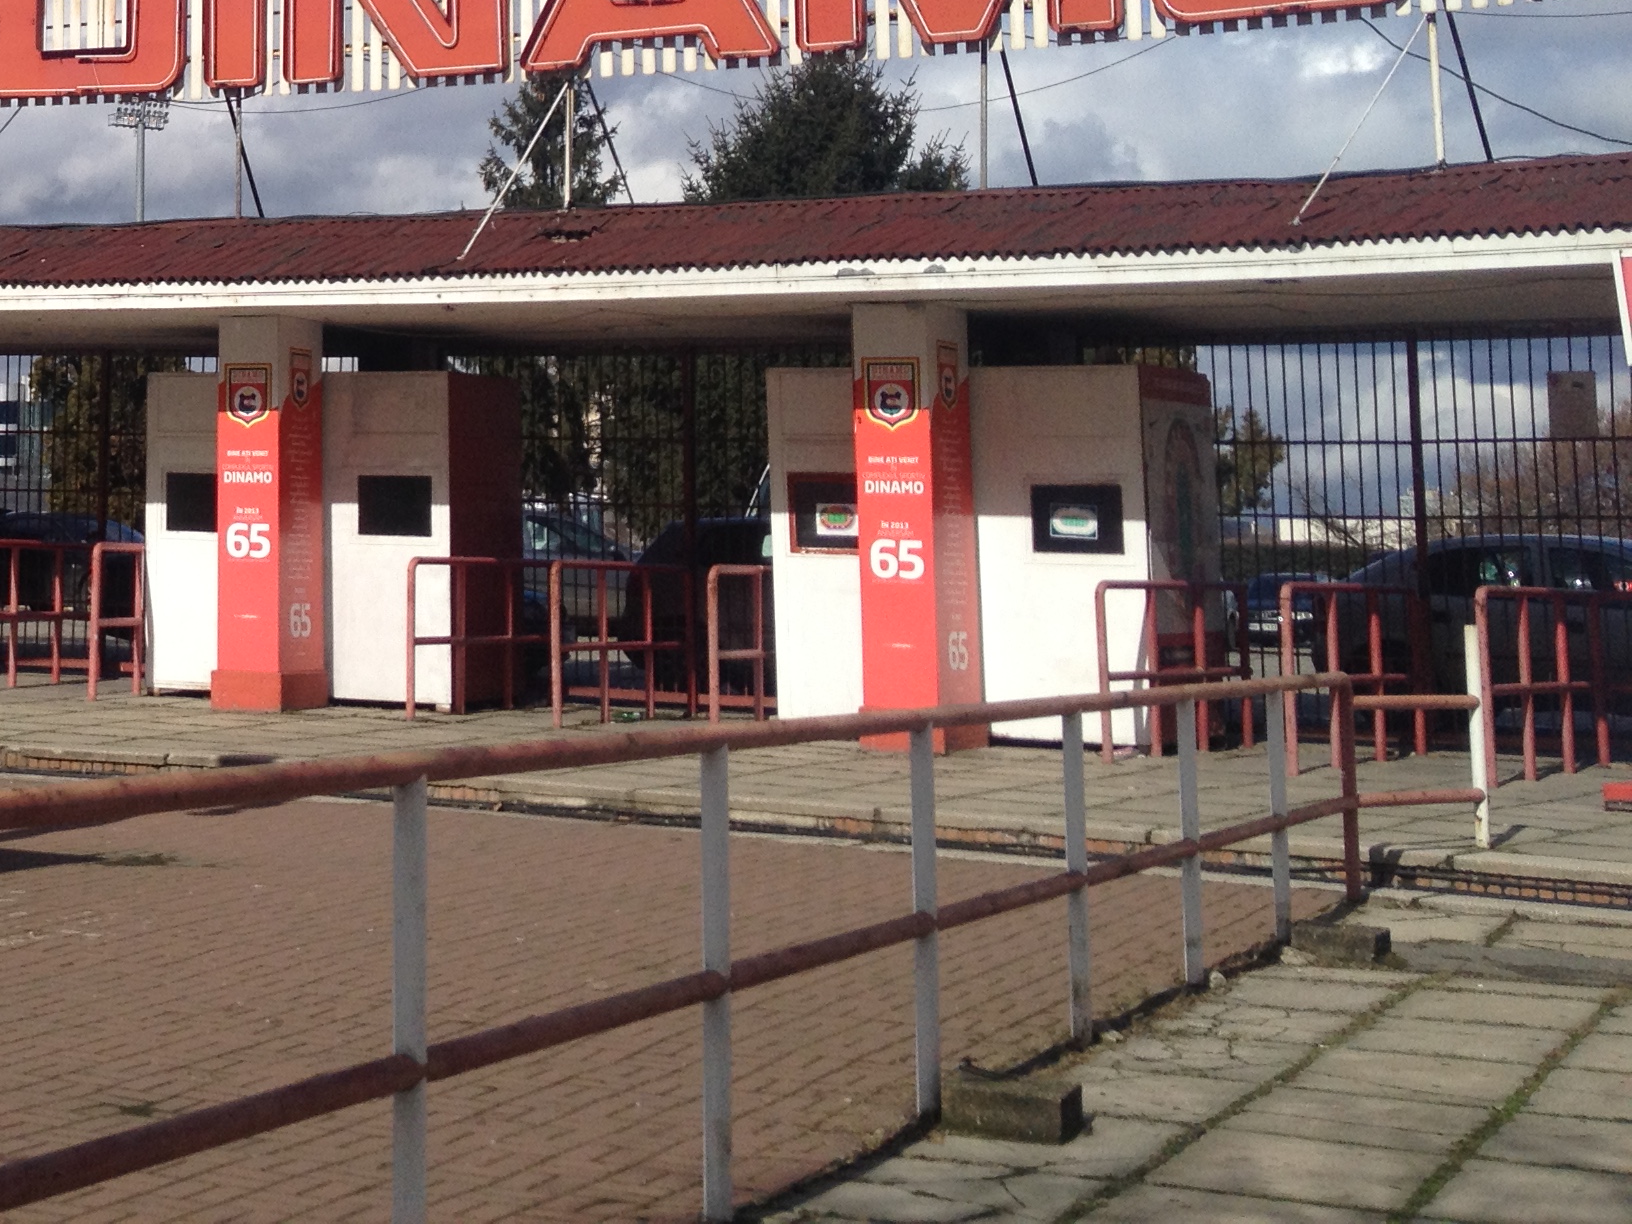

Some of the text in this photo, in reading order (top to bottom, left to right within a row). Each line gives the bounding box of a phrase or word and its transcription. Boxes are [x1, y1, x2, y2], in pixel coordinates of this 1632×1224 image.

[223, 470, 273, 484] DINAMO
[864, 480, 925, 495] DINAMO
[226, 522, 271, 559] 65
[890, 521, 909, 529] 2013
[870, 538, 925, 580] 65
[290, 602, 312, 638] 65
[948, 631, 968, 671] 65
